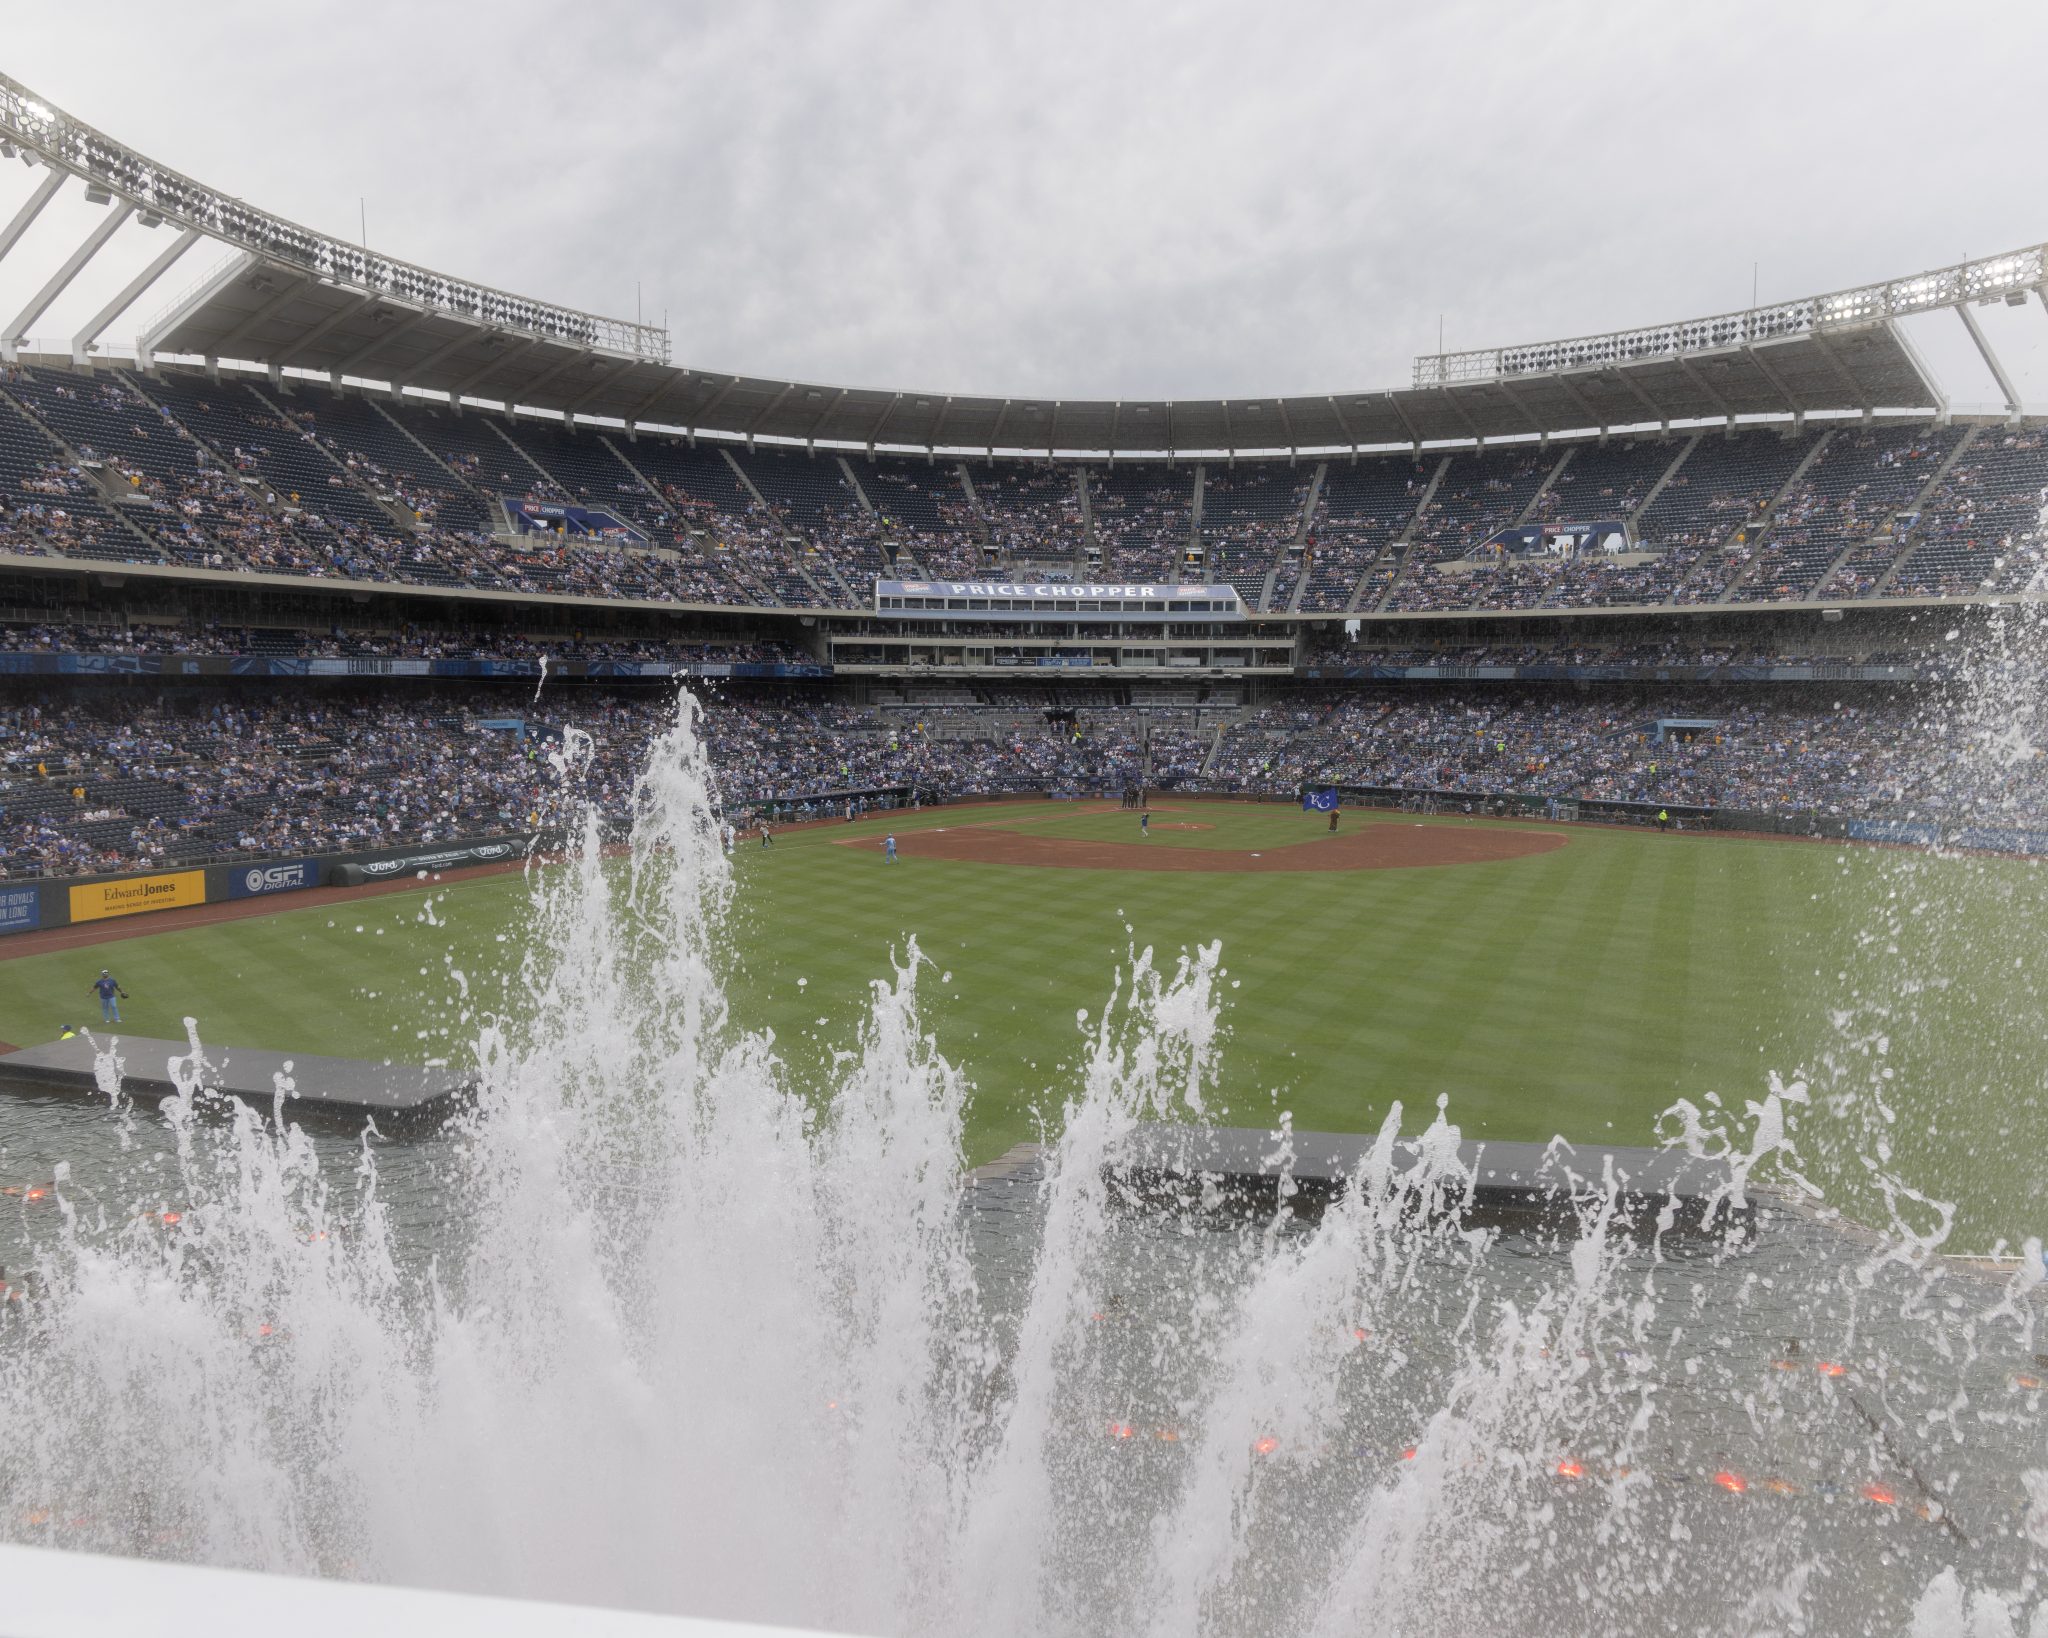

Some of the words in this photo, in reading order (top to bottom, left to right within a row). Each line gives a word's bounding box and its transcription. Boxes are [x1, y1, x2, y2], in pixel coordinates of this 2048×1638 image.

[524, 504, 539, 512] PRICE
[541, 506, 565, 515] CHOPPER
[1563, 525, 1590, 533] CHOPPER
[952, 584, 1027, 596] PRICE
[1034, 586, 1155, 597] CHOPPER
[348, 659, 379, 674] LEADING
[380, 659, 393, 674] OFF
[1439, 666, 1467, 678] LEADING
[478, 845, 502, 856] Ford
[368, 860, 398, 872] Ford
[264, 879, 304, 890] DIGITAL
[104, 884, 143, 901] Edward
[144, 883, 176, 897] Jones
[9, 891, 35, 906] ROYALS
[9, 905, 28, 918] LONG
